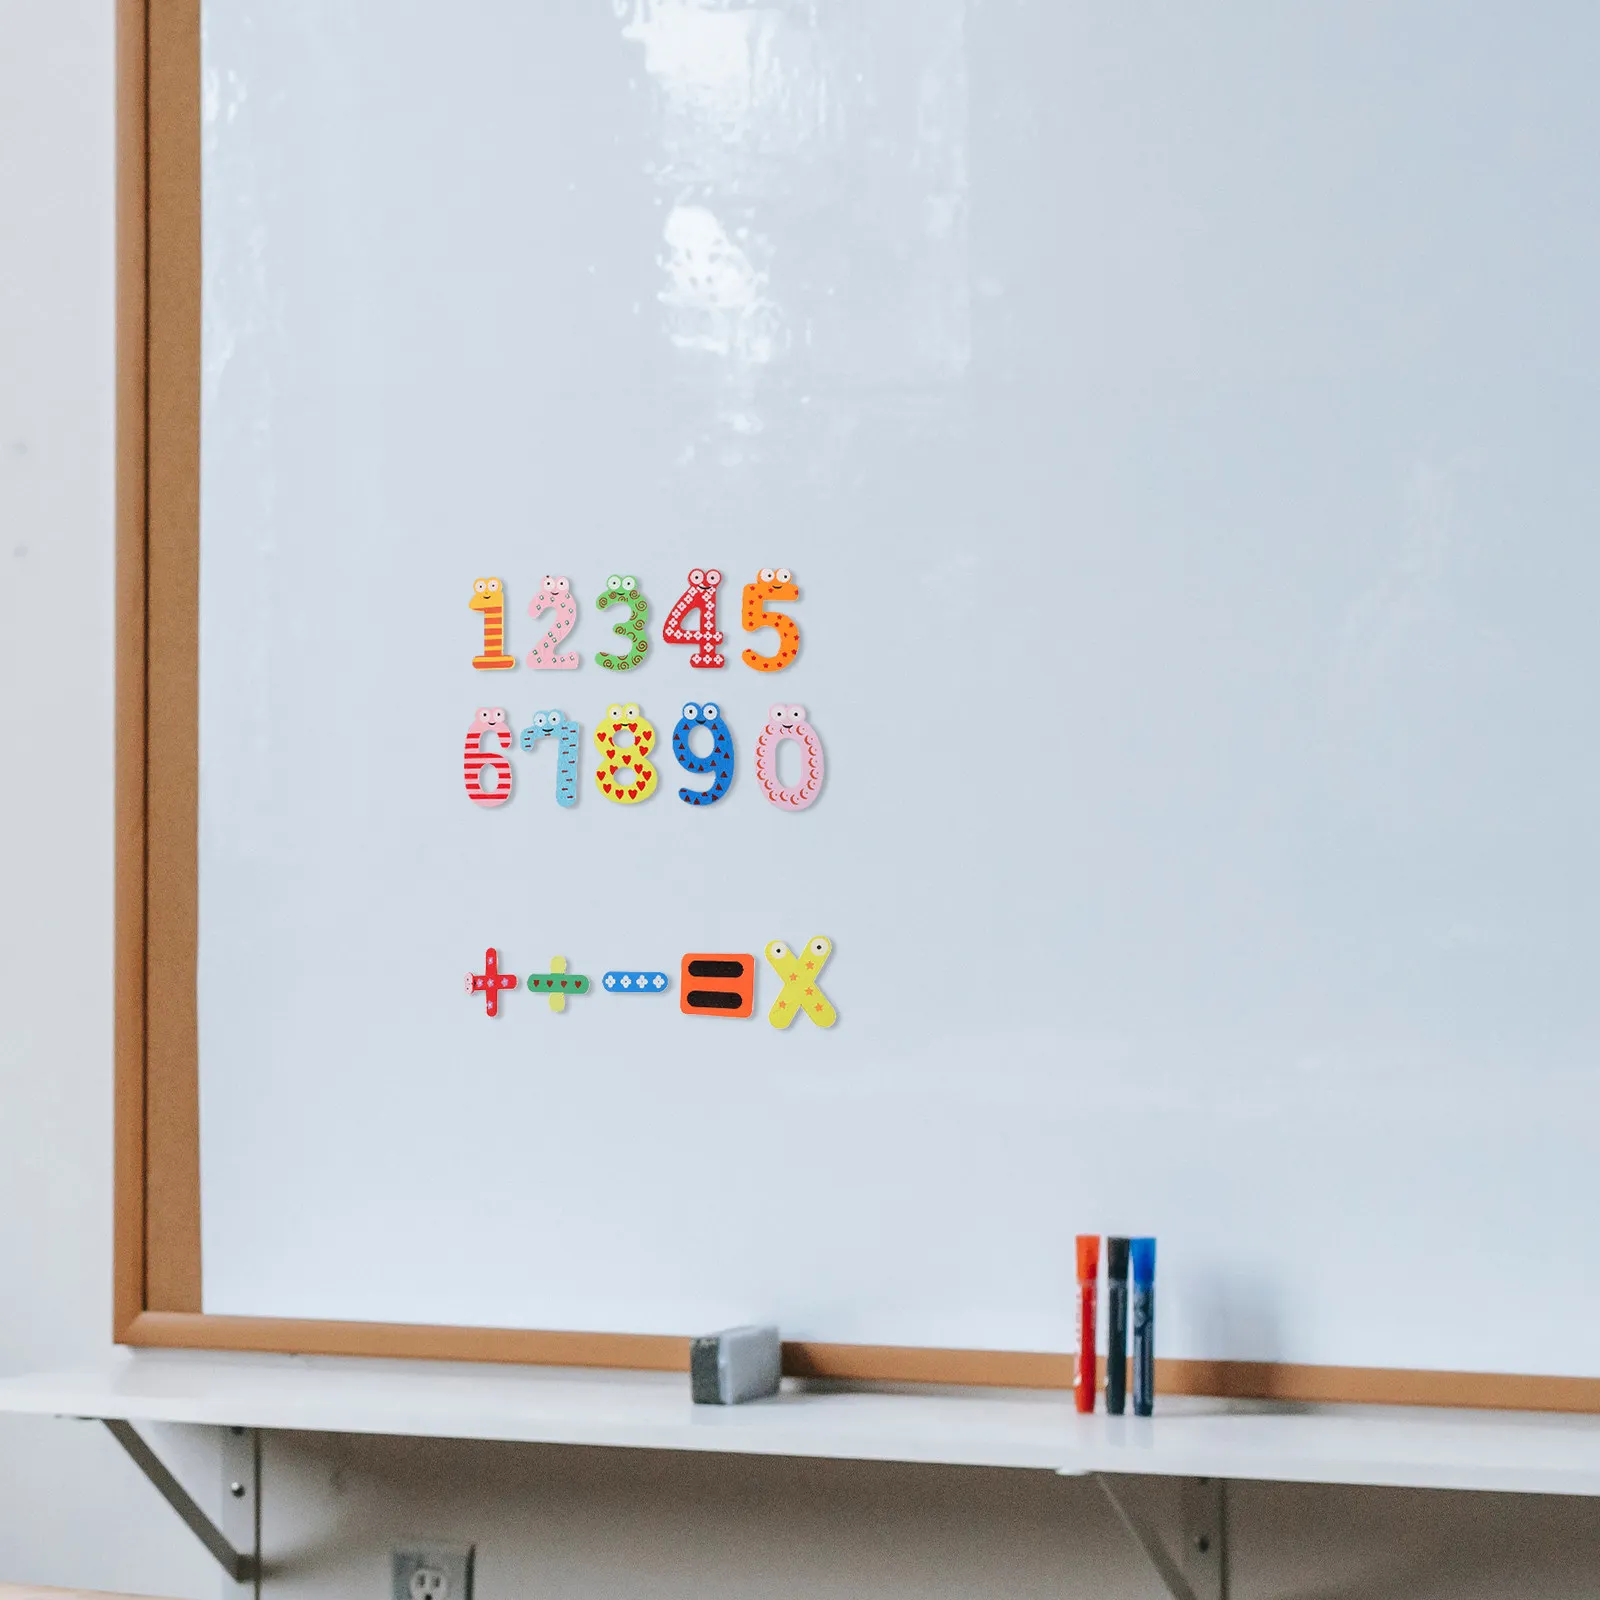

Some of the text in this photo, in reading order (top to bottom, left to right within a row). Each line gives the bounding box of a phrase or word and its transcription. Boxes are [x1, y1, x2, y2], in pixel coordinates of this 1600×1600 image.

[468, 568, 804, 672] 1 2 3 4 5
[464, 706, 512, 807] 6
[520, 709, 580, 808] 7
[594, 703, 658, 804] 8
[672, 702, 735, 806] 9
